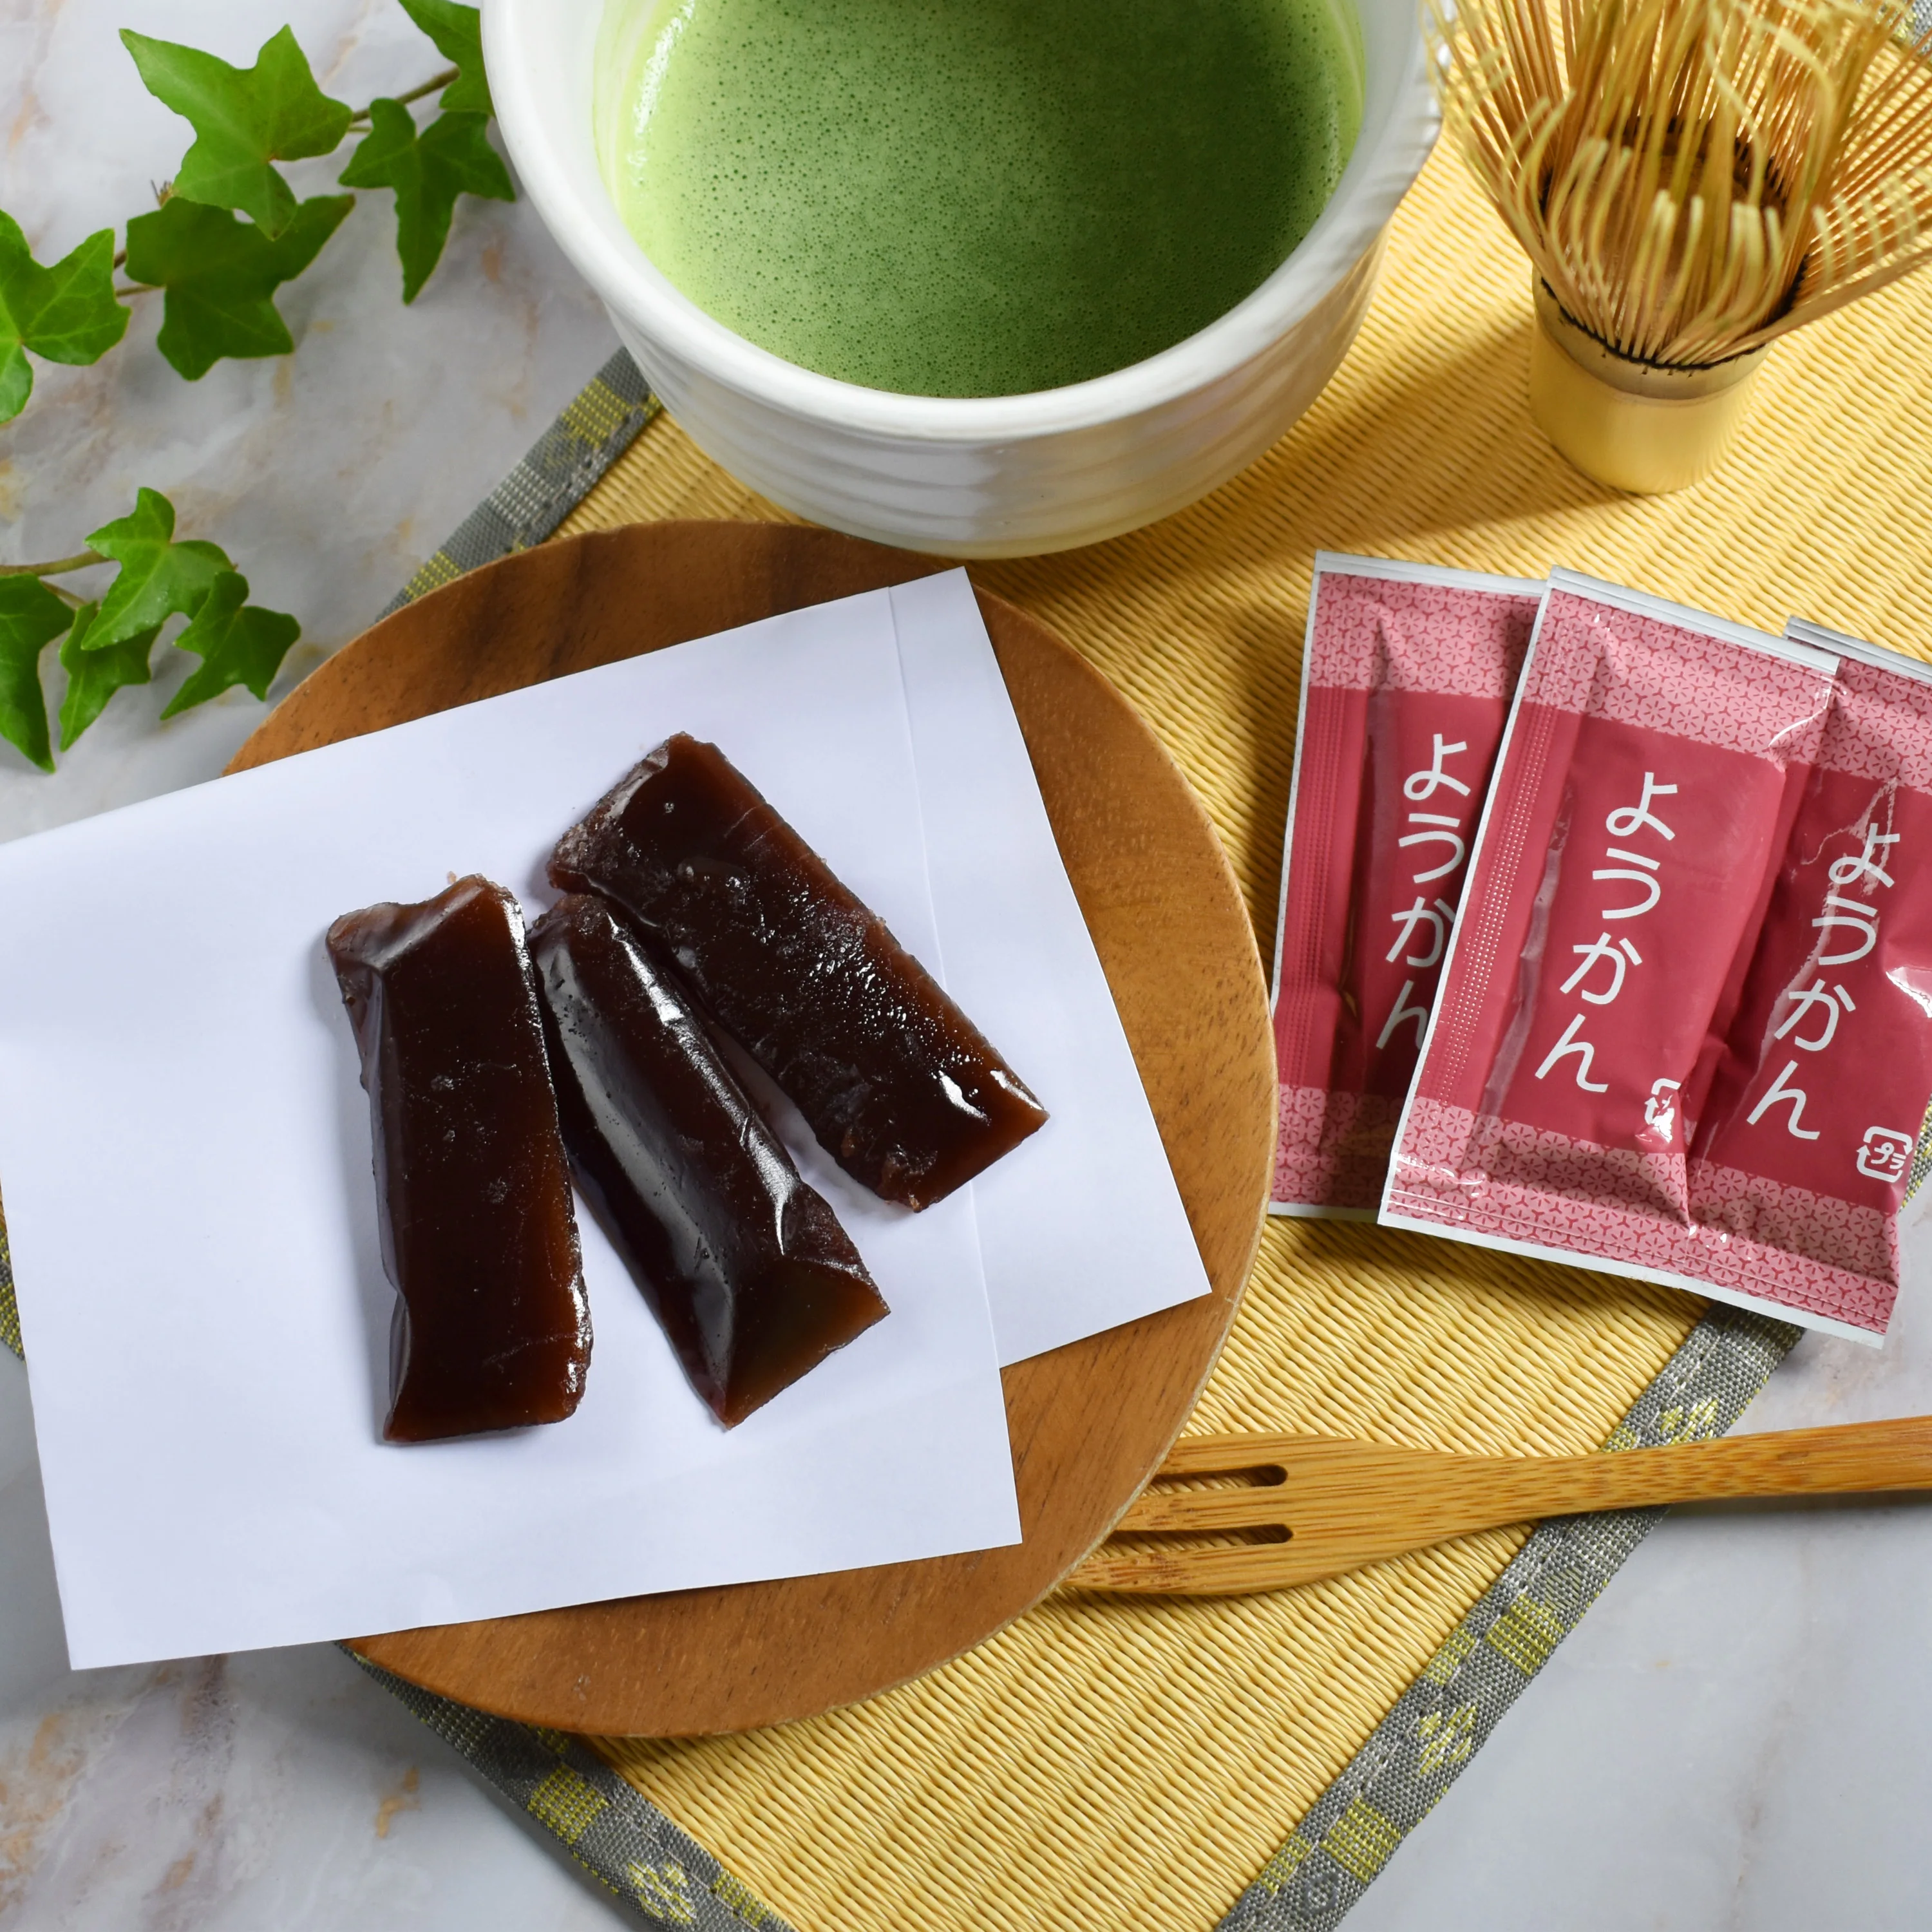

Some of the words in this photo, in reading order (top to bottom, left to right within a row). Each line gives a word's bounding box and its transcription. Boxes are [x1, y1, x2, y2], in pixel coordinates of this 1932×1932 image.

[1535, 772, 1678, 1093] ようかん
[1747, 822, 1900, 1140] ようかん
[1870, 1142, 1906, 1170] プラ
